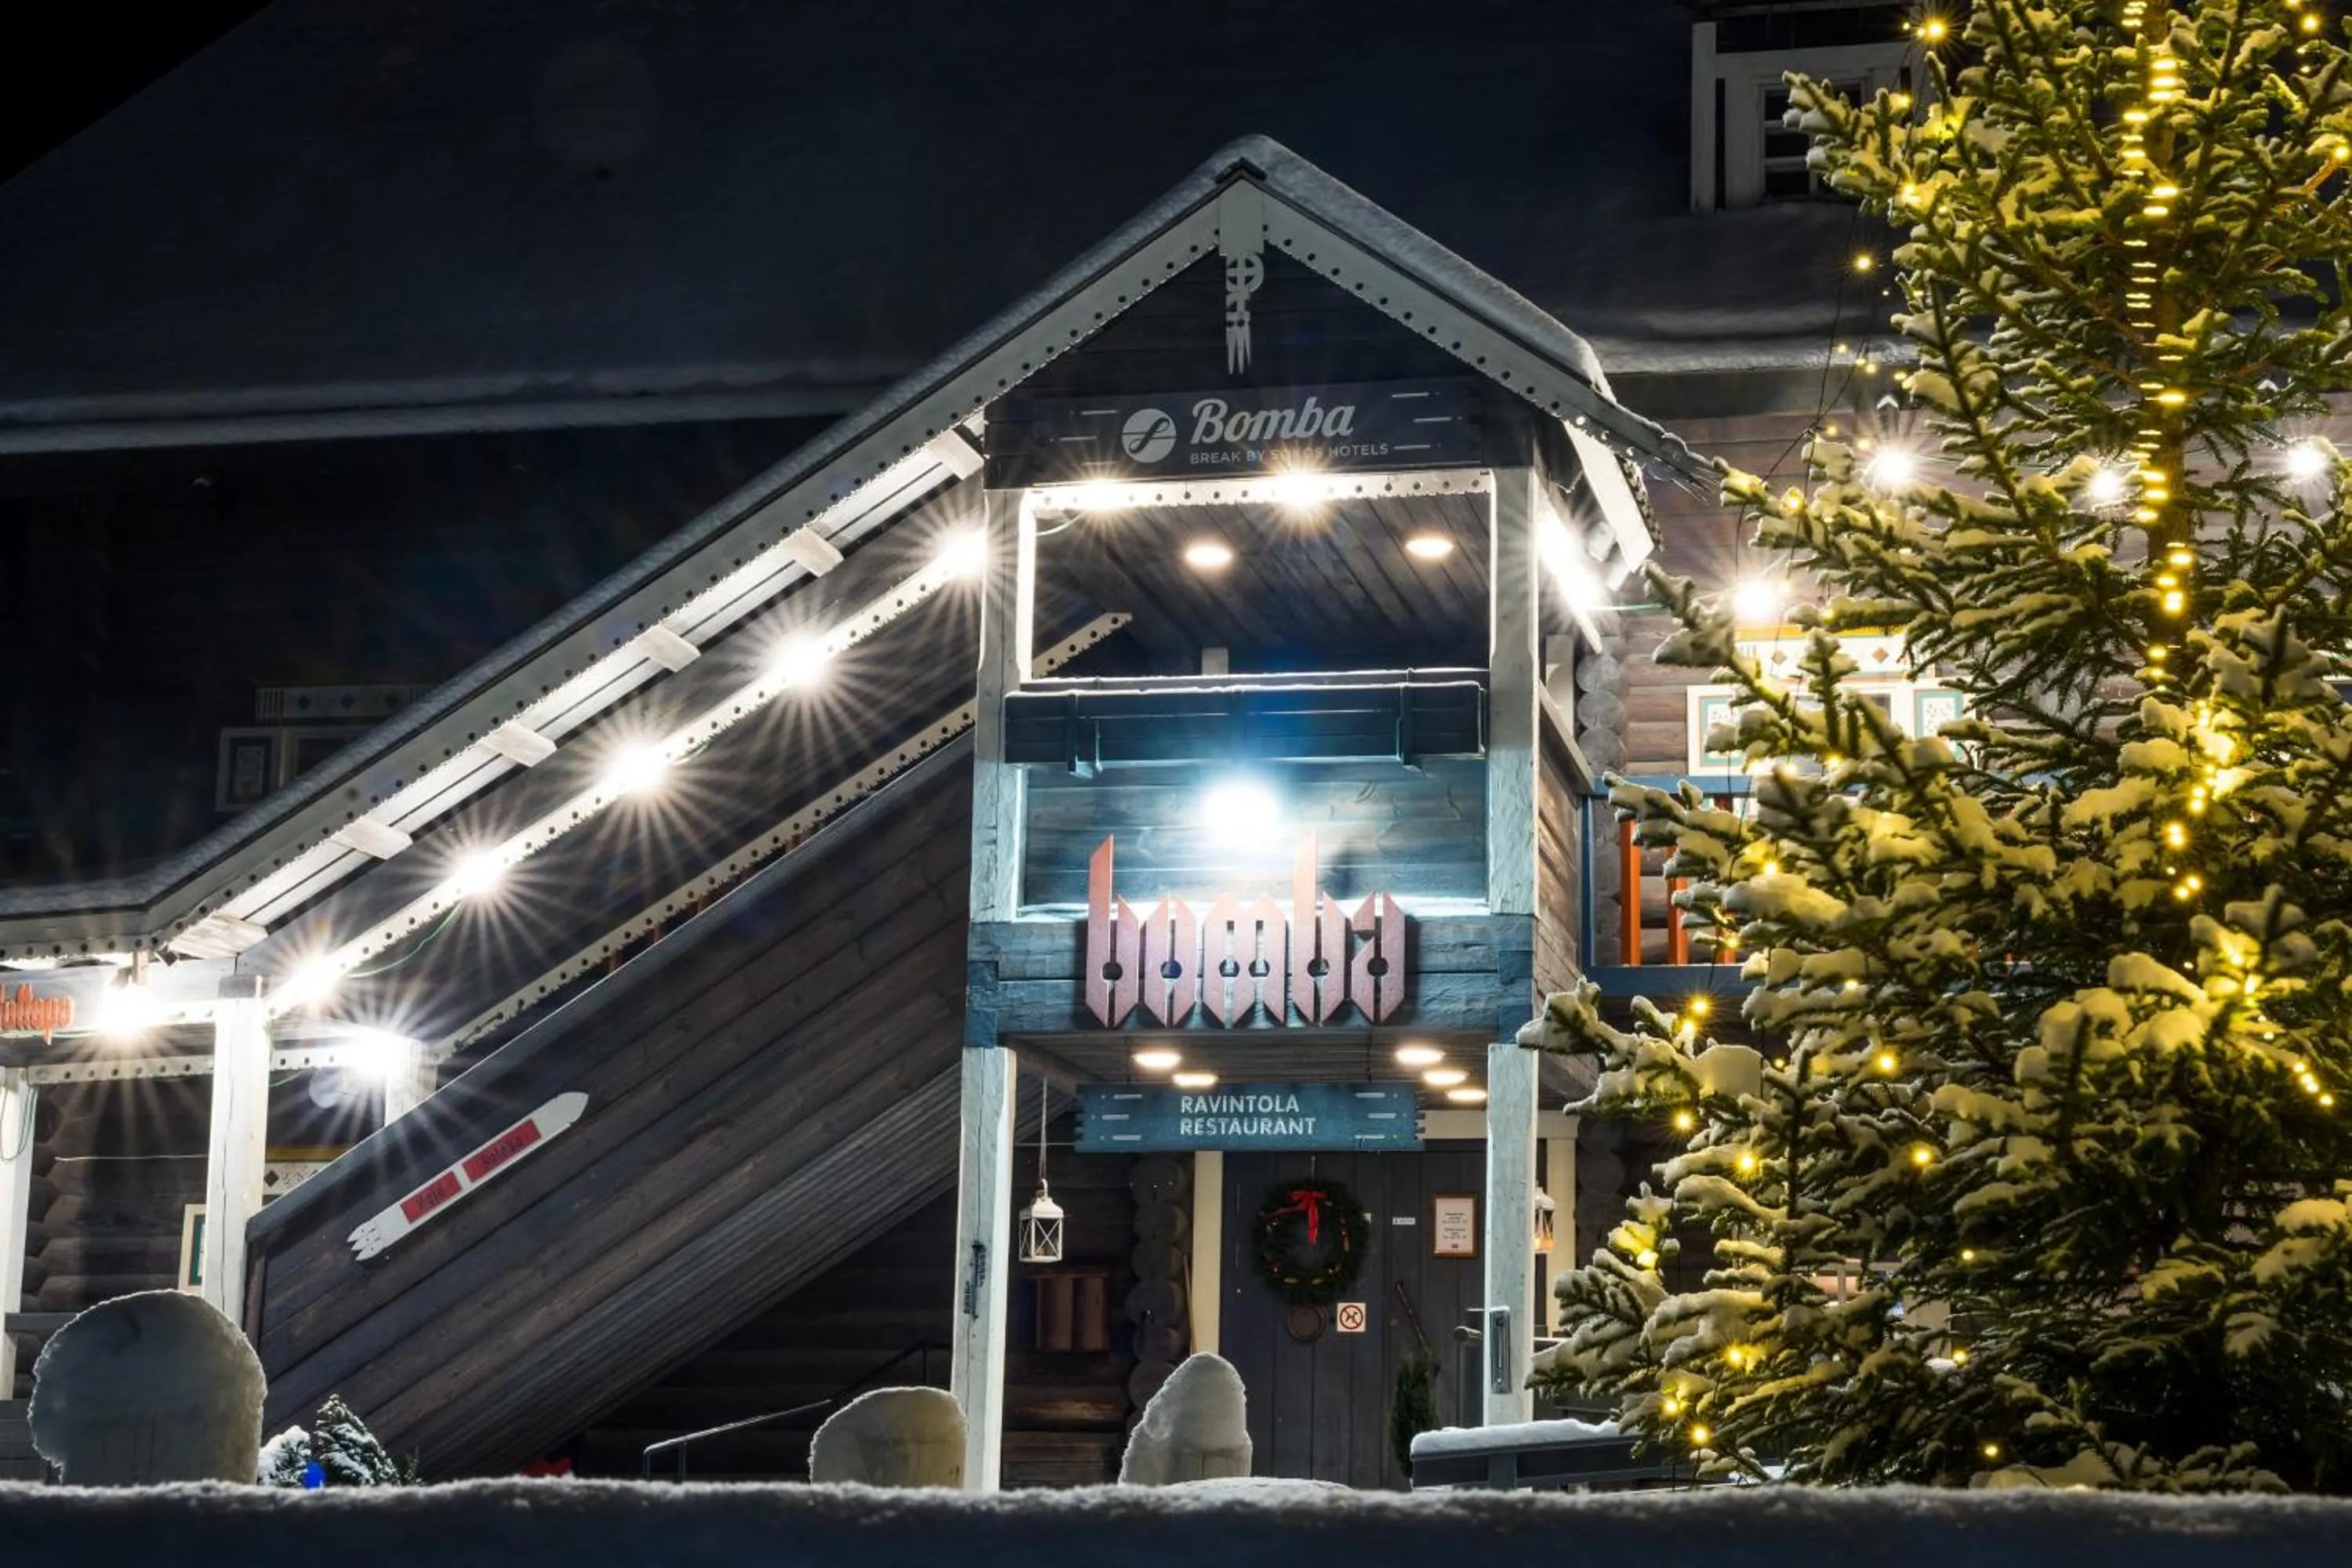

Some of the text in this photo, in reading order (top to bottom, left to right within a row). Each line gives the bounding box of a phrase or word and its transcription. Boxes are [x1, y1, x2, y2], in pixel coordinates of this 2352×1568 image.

[1189, 396, 1356, 445] Bomba
[1189, 451, 1241, 465] BREAK
[1247, 450, 1265, 463] BY
[1328, 443, 1389, 458] HOTELS
[1085, 831, 1406, 1029] bomba
[1181, 1094, 1300, 1114] RAVINTOLA
[1179, 1117, 1317, 1136] RESTAURANT
